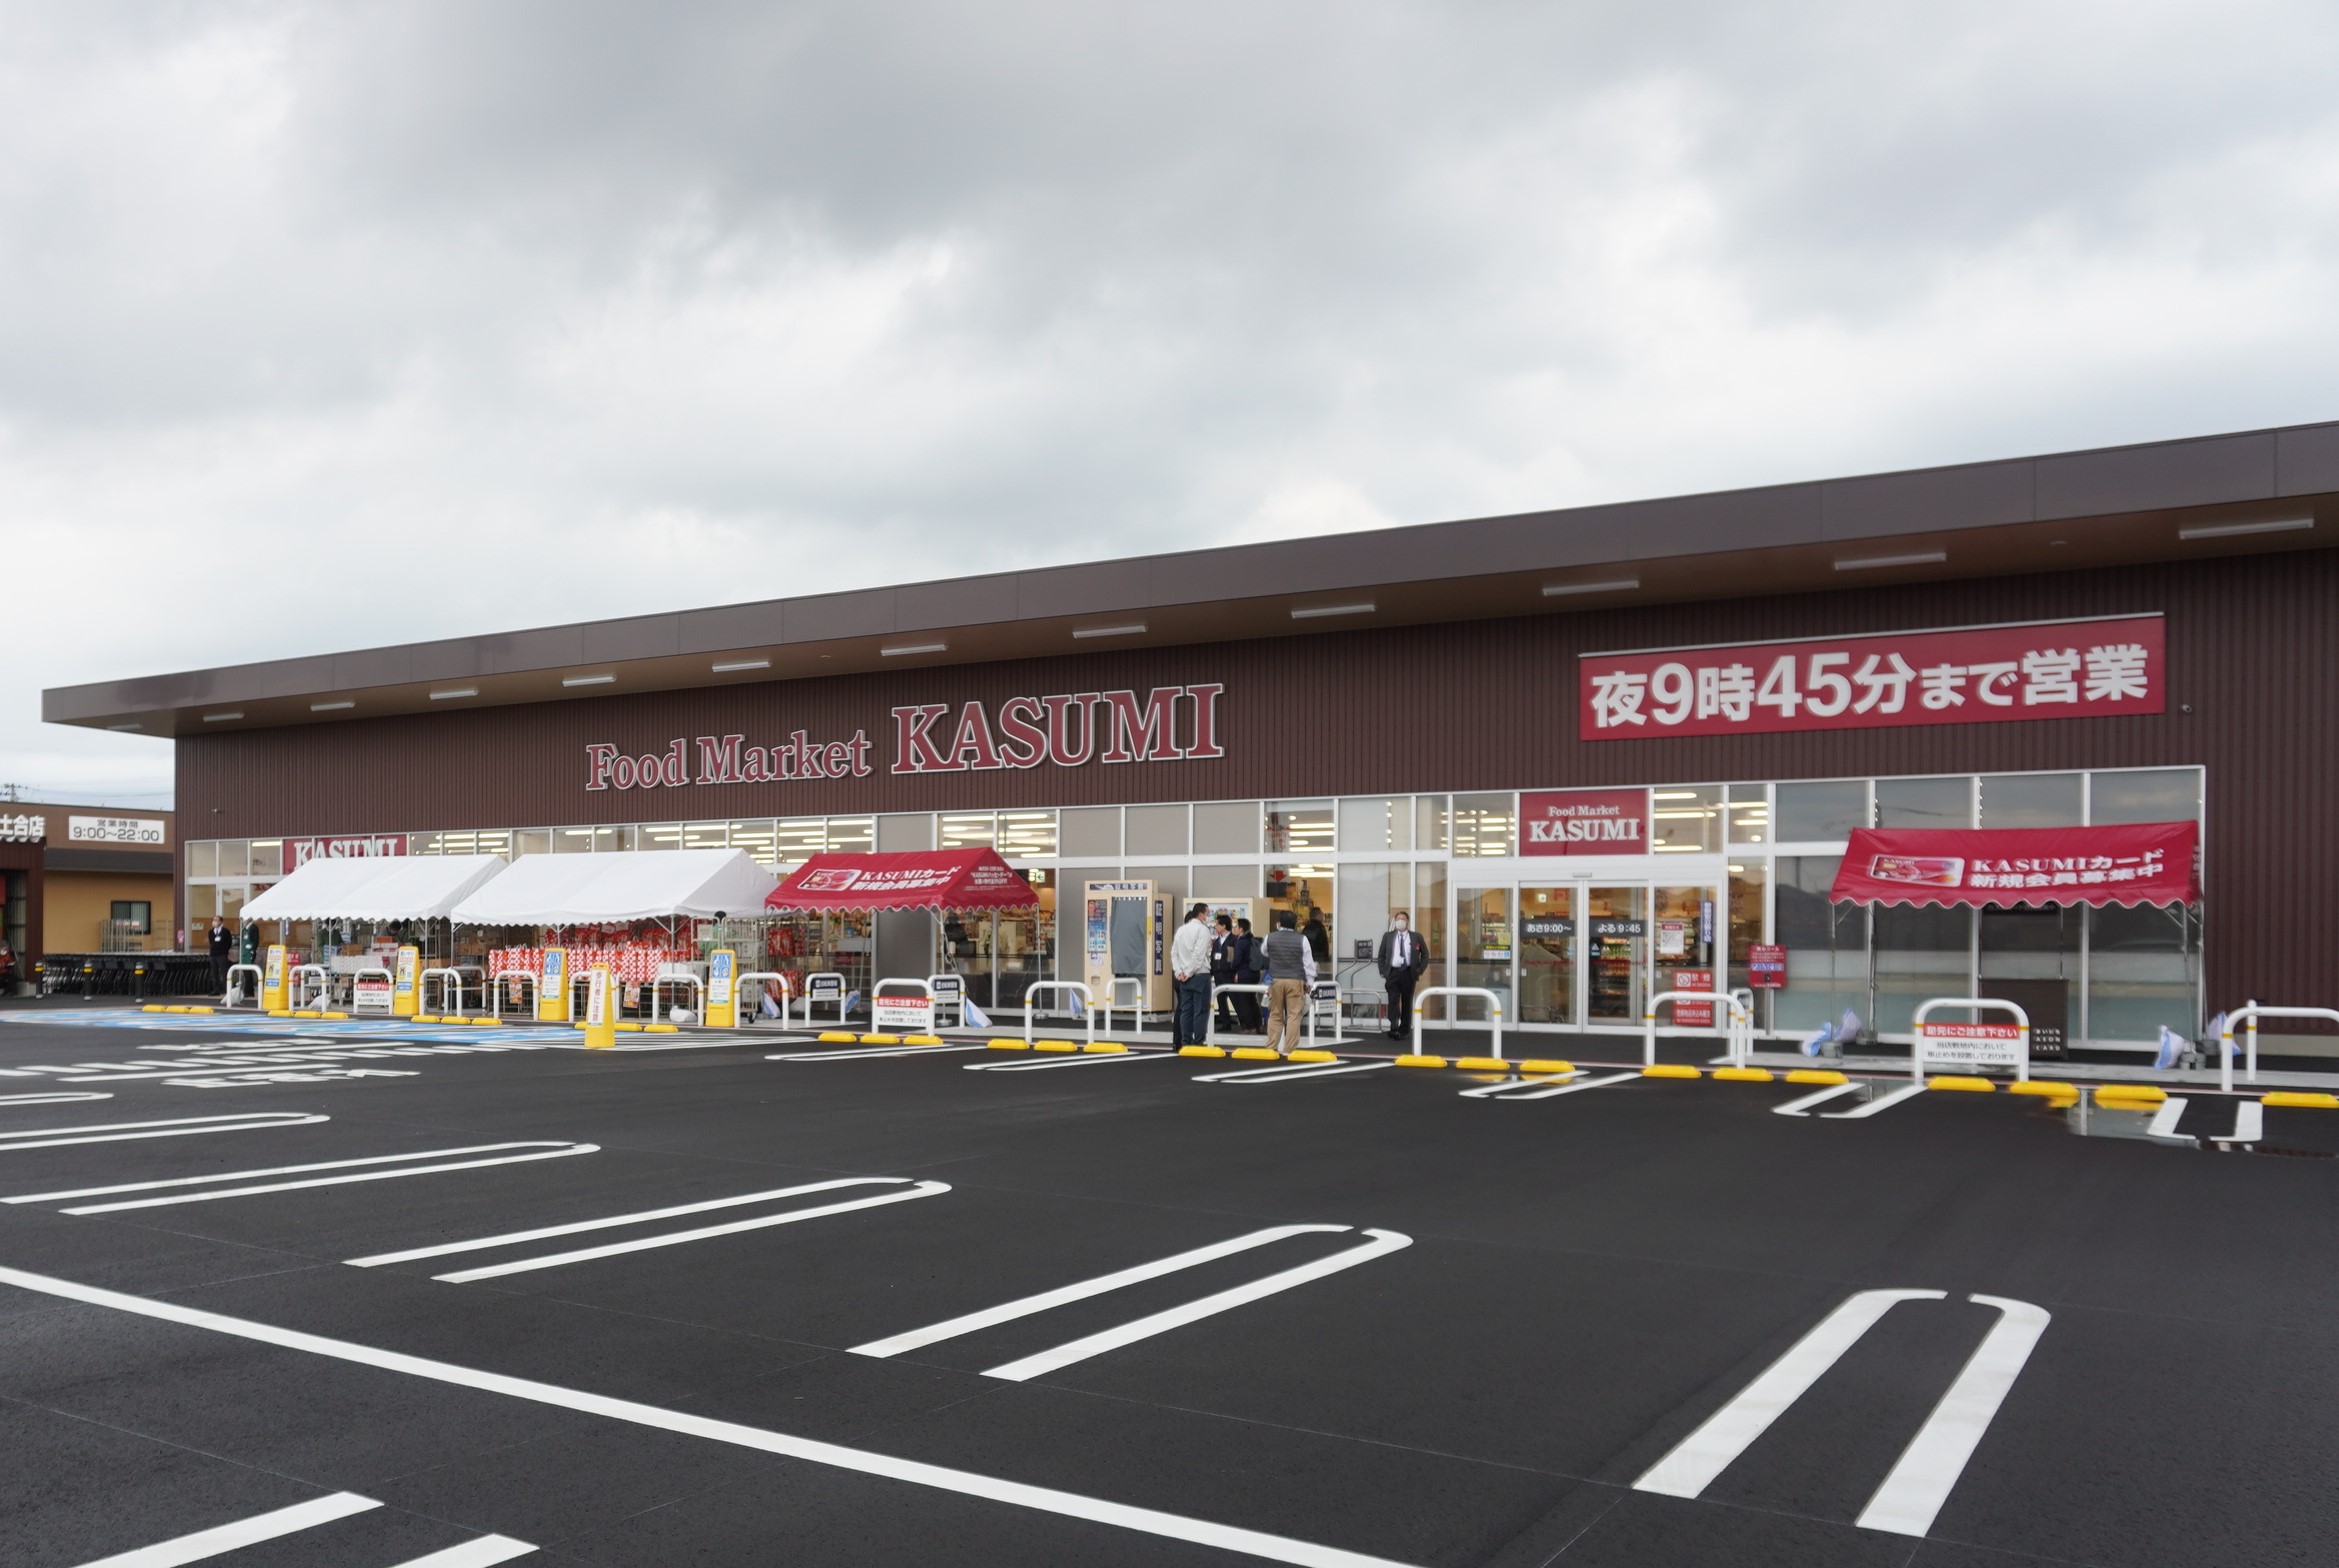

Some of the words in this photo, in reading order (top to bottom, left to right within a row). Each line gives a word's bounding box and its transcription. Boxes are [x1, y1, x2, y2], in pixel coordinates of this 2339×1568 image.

[1591, 643, 2148, 728] 夜9時45分まで営業
[586, 738, 690, 791] Food
[696, 729, 873, 785] Market
[892, 683, 1225, 775] KASUMI
[1548, 806, 1576, 817] Food
[1578, 805, 1620, 816] Market
[97, 819, 139, 828] 営業時間
[1529, 818, 1640, 842] KASUMI
[1971, 848, 2165, 873] KASUMIカード
[861, 866, 961, 881] KASUMIカード
[1970, 863, 2164, 889] 新規会員募集中
[1155, 903, 1163, 973] 証明写真
[1926, 1025, 2018, 1037] 足元にご注意下さい
[1936, 1041, 2006, 1050] 当店敷地内において
[1927, 1051, 2015, 1061] 車止めを設置しております
